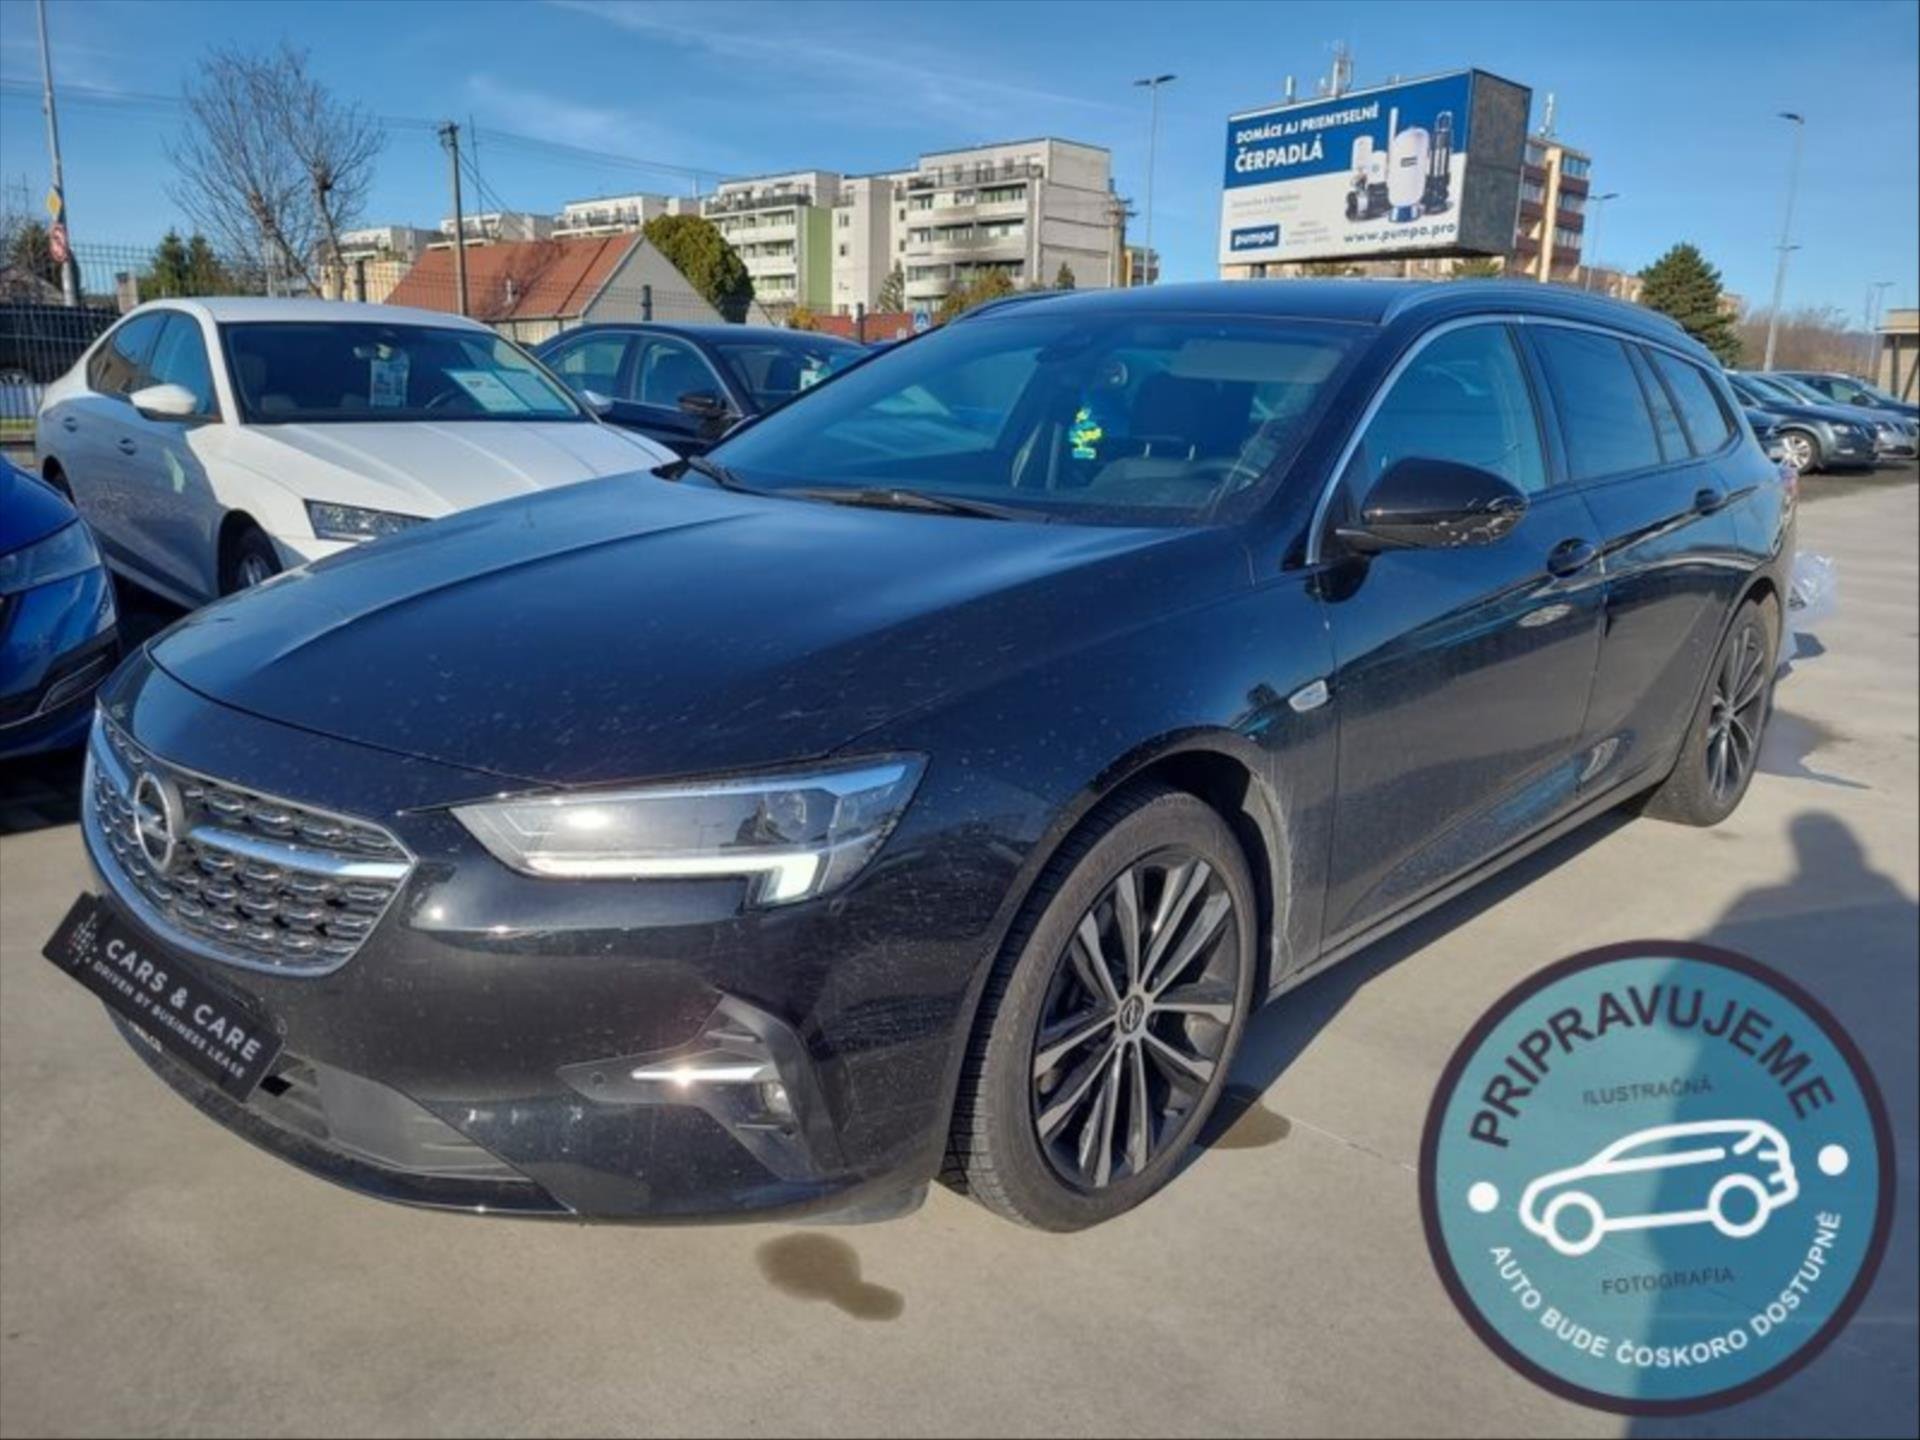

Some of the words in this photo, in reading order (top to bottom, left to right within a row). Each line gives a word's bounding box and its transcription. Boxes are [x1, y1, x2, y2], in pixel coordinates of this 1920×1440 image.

[1236, 123, 1282, 144] DOMÁCE
[1284, 121, 1298, 135] AJ
[1301, 101, 1379, 132] PRIEMYSELNÉ
[1234, 133, 1323, 173] ČERPADLÁ
[1344, 223, 1456, 243] www.pumpa.pro
[93, 961, 134, 997] DRIVEN
[135, 991, 151, 1008] BY
[151, 1004, 207, 1051] BUSINESS
[207, 1046, 246, 1078] LEASE
[106, 939, 168, 992] CARS
[170, 987, 188, 1010] &
[193, 1004, 261, 1061] CARE
